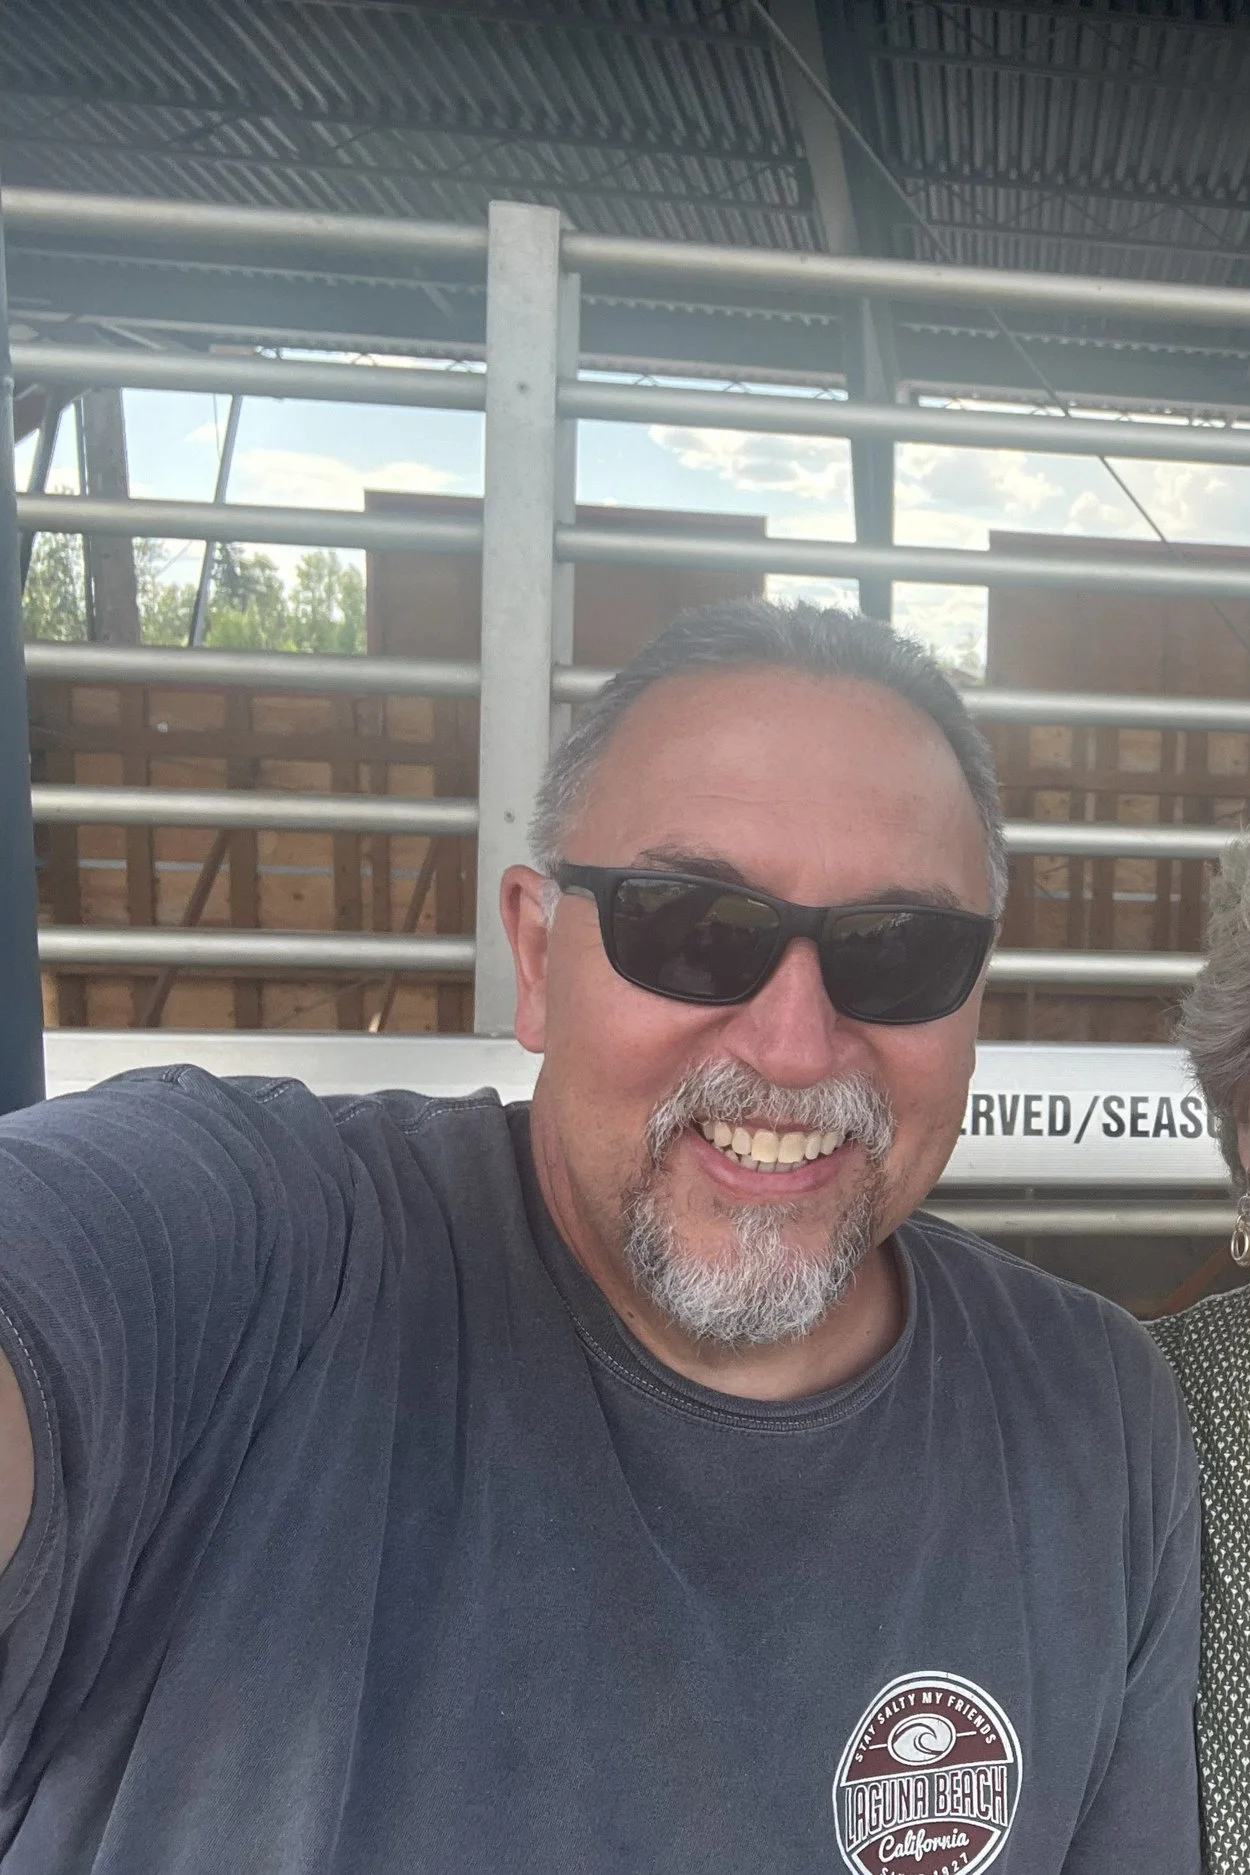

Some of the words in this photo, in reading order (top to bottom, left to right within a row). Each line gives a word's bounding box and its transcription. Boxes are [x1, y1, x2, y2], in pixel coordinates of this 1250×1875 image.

[960, 1093, 1220, 1144] RVED/SEAS
[855, 1725, 876, 1762] STAY
[877, 1693, 915, 1724] SALTY
[922, 1692, 943, 1704] MY
[947, 1695, 997, 1745] FRIENDS
[845, 1774, 929, 1852] LAGUNA
[935, 1765, 1009, 1828] BEACH
[878, 1828, 970, 1863] California
